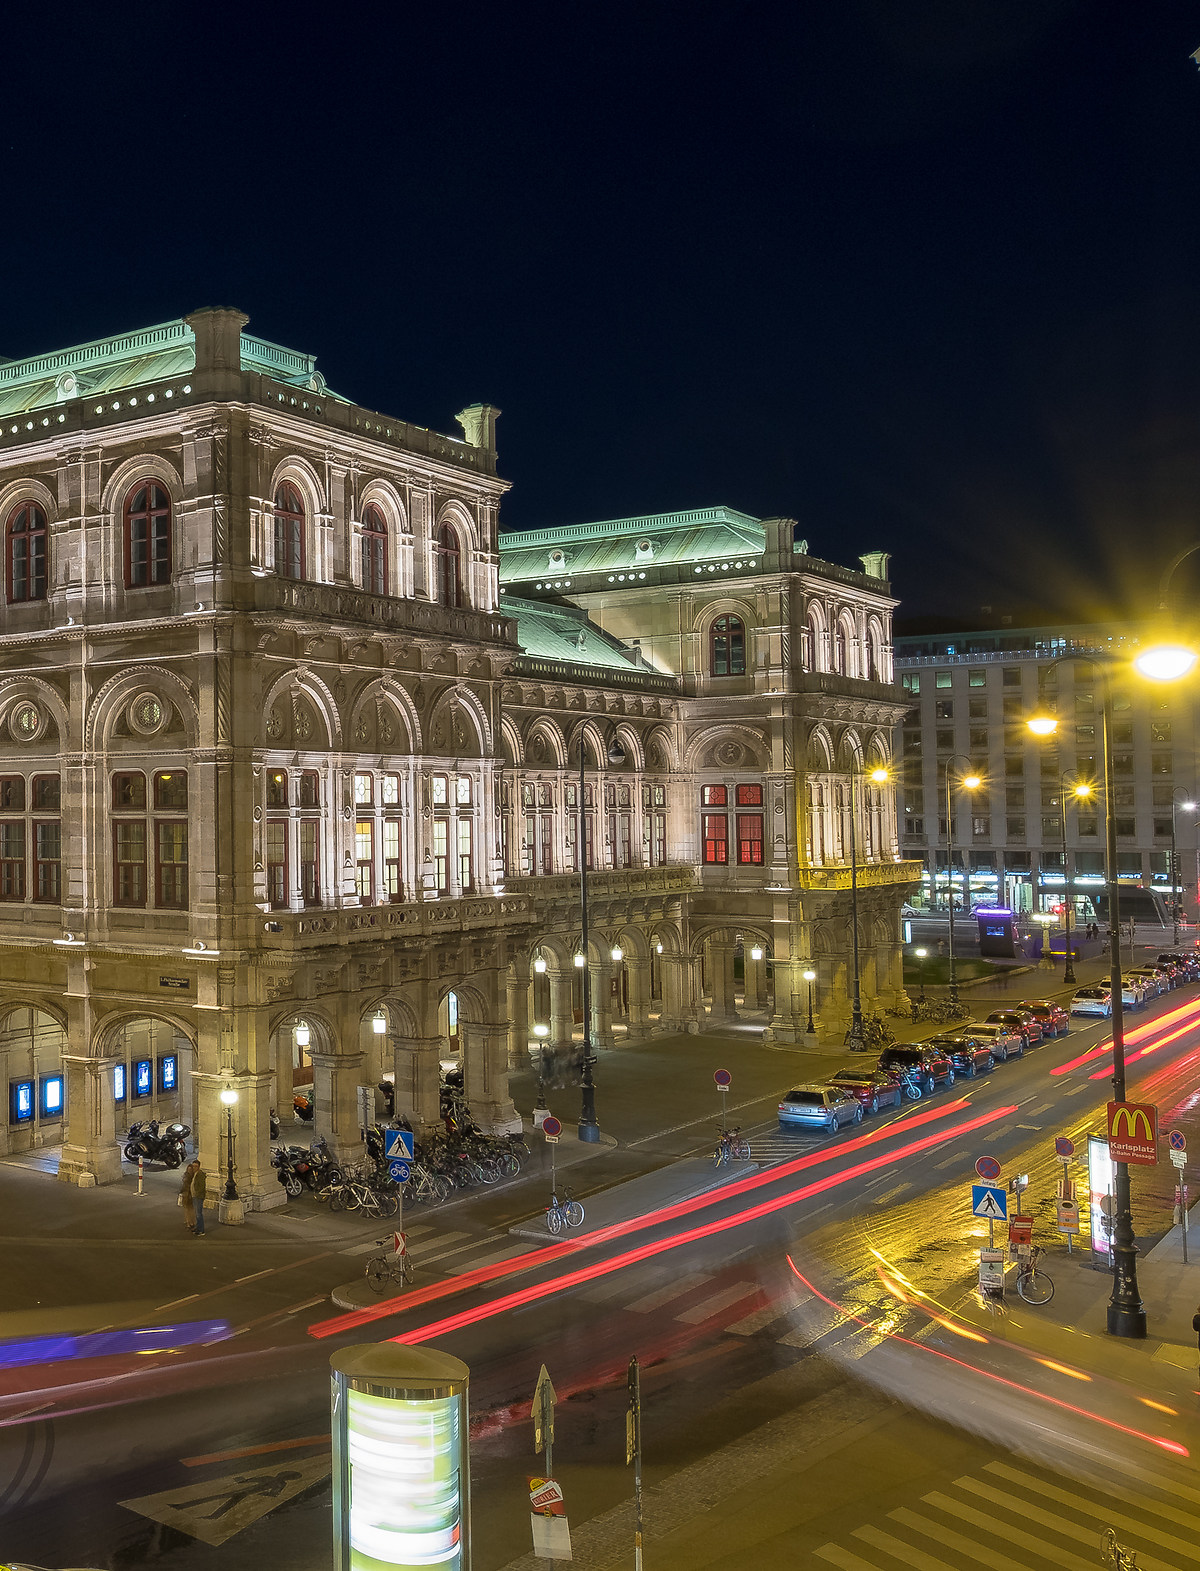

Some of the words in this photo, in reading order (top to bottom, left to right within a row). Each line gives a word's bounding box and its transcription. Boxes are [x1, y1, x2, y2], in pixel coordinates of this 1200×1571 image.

[1110, 1142, 1155, 1153] Karlsplatz
[1132, 1152, 1156, 1160] Passage
[533, 1490, 559, 1505] KURIER
